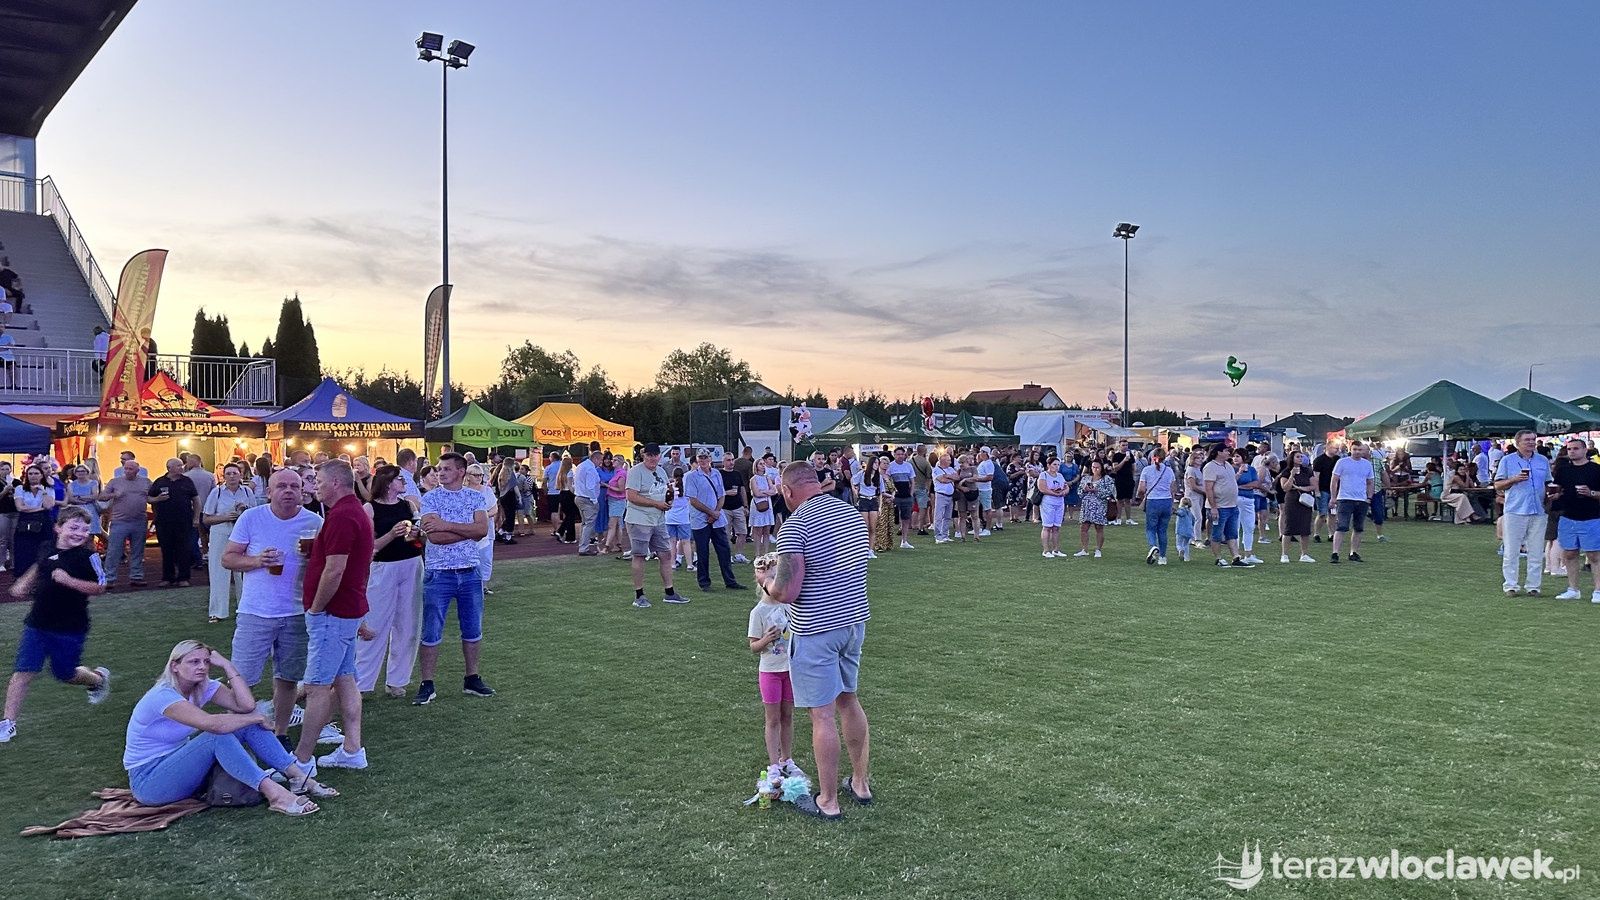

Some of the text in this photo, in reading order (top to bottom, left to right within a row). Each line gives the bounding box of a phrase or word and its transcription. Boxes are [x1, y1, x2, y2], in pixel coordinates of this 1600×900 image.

[129, 421, 238, 435] Frytki Belgijskie
[360, 422, 412, 431] ZIEMNIAK
[334, 430, 381, 438] NA PATYKU
[461, 428, 491, 437] LODY
[497, 428, 526, 437] LODY
[541, 428, 567, 437] GOFRY
[572, 429, 597, 438] GOFRY
[602, 429, 627, 438] GOFRY
